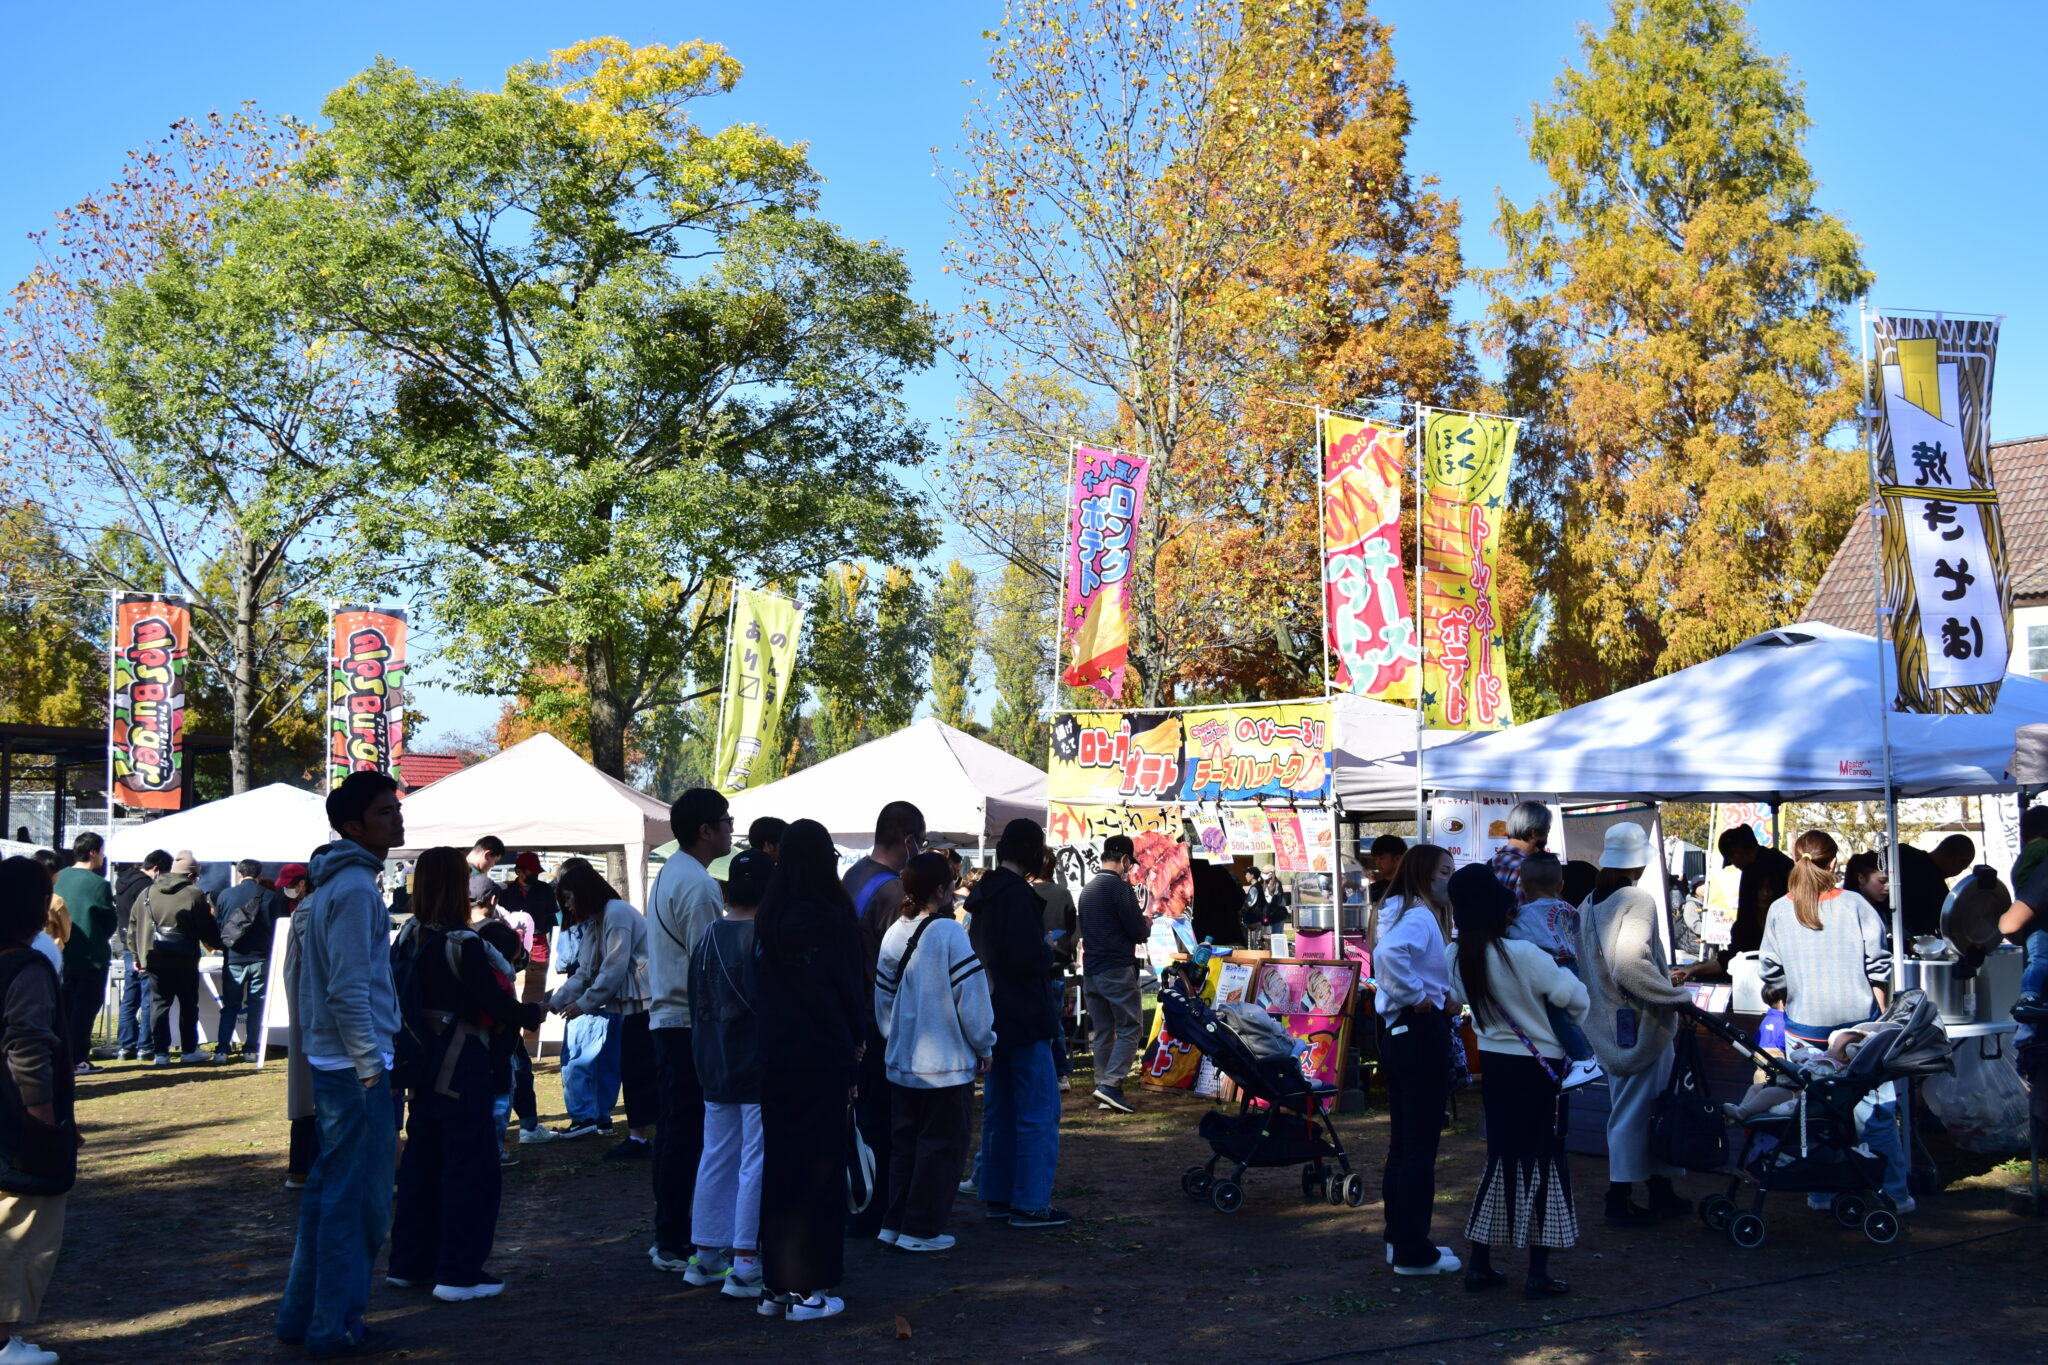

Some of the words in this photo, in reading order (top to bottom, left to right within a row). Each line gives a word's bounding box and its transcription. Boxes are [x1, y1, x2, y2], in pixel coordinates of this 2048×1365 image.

[1078, 495, 1111, 598] ポテト
[1100, 484, 1137, 584] ロング
[1363, 537, 1418, 667] チーズ
[1468, 503, 1501, 724] トルネード
[1438, 604, 1475, 725] ポテト
[131, 684, 167, 784] Burger
[351, 696, 384, 773] Burge
[1060, 737, 1077, 754] たて
[1079, 719, 1131, 771] ロング
[1118, 745, 1178, 797] ポテト
[1191, 720, 1217, 738] Cheese
[1201, 732, 1216, 747] Hot
